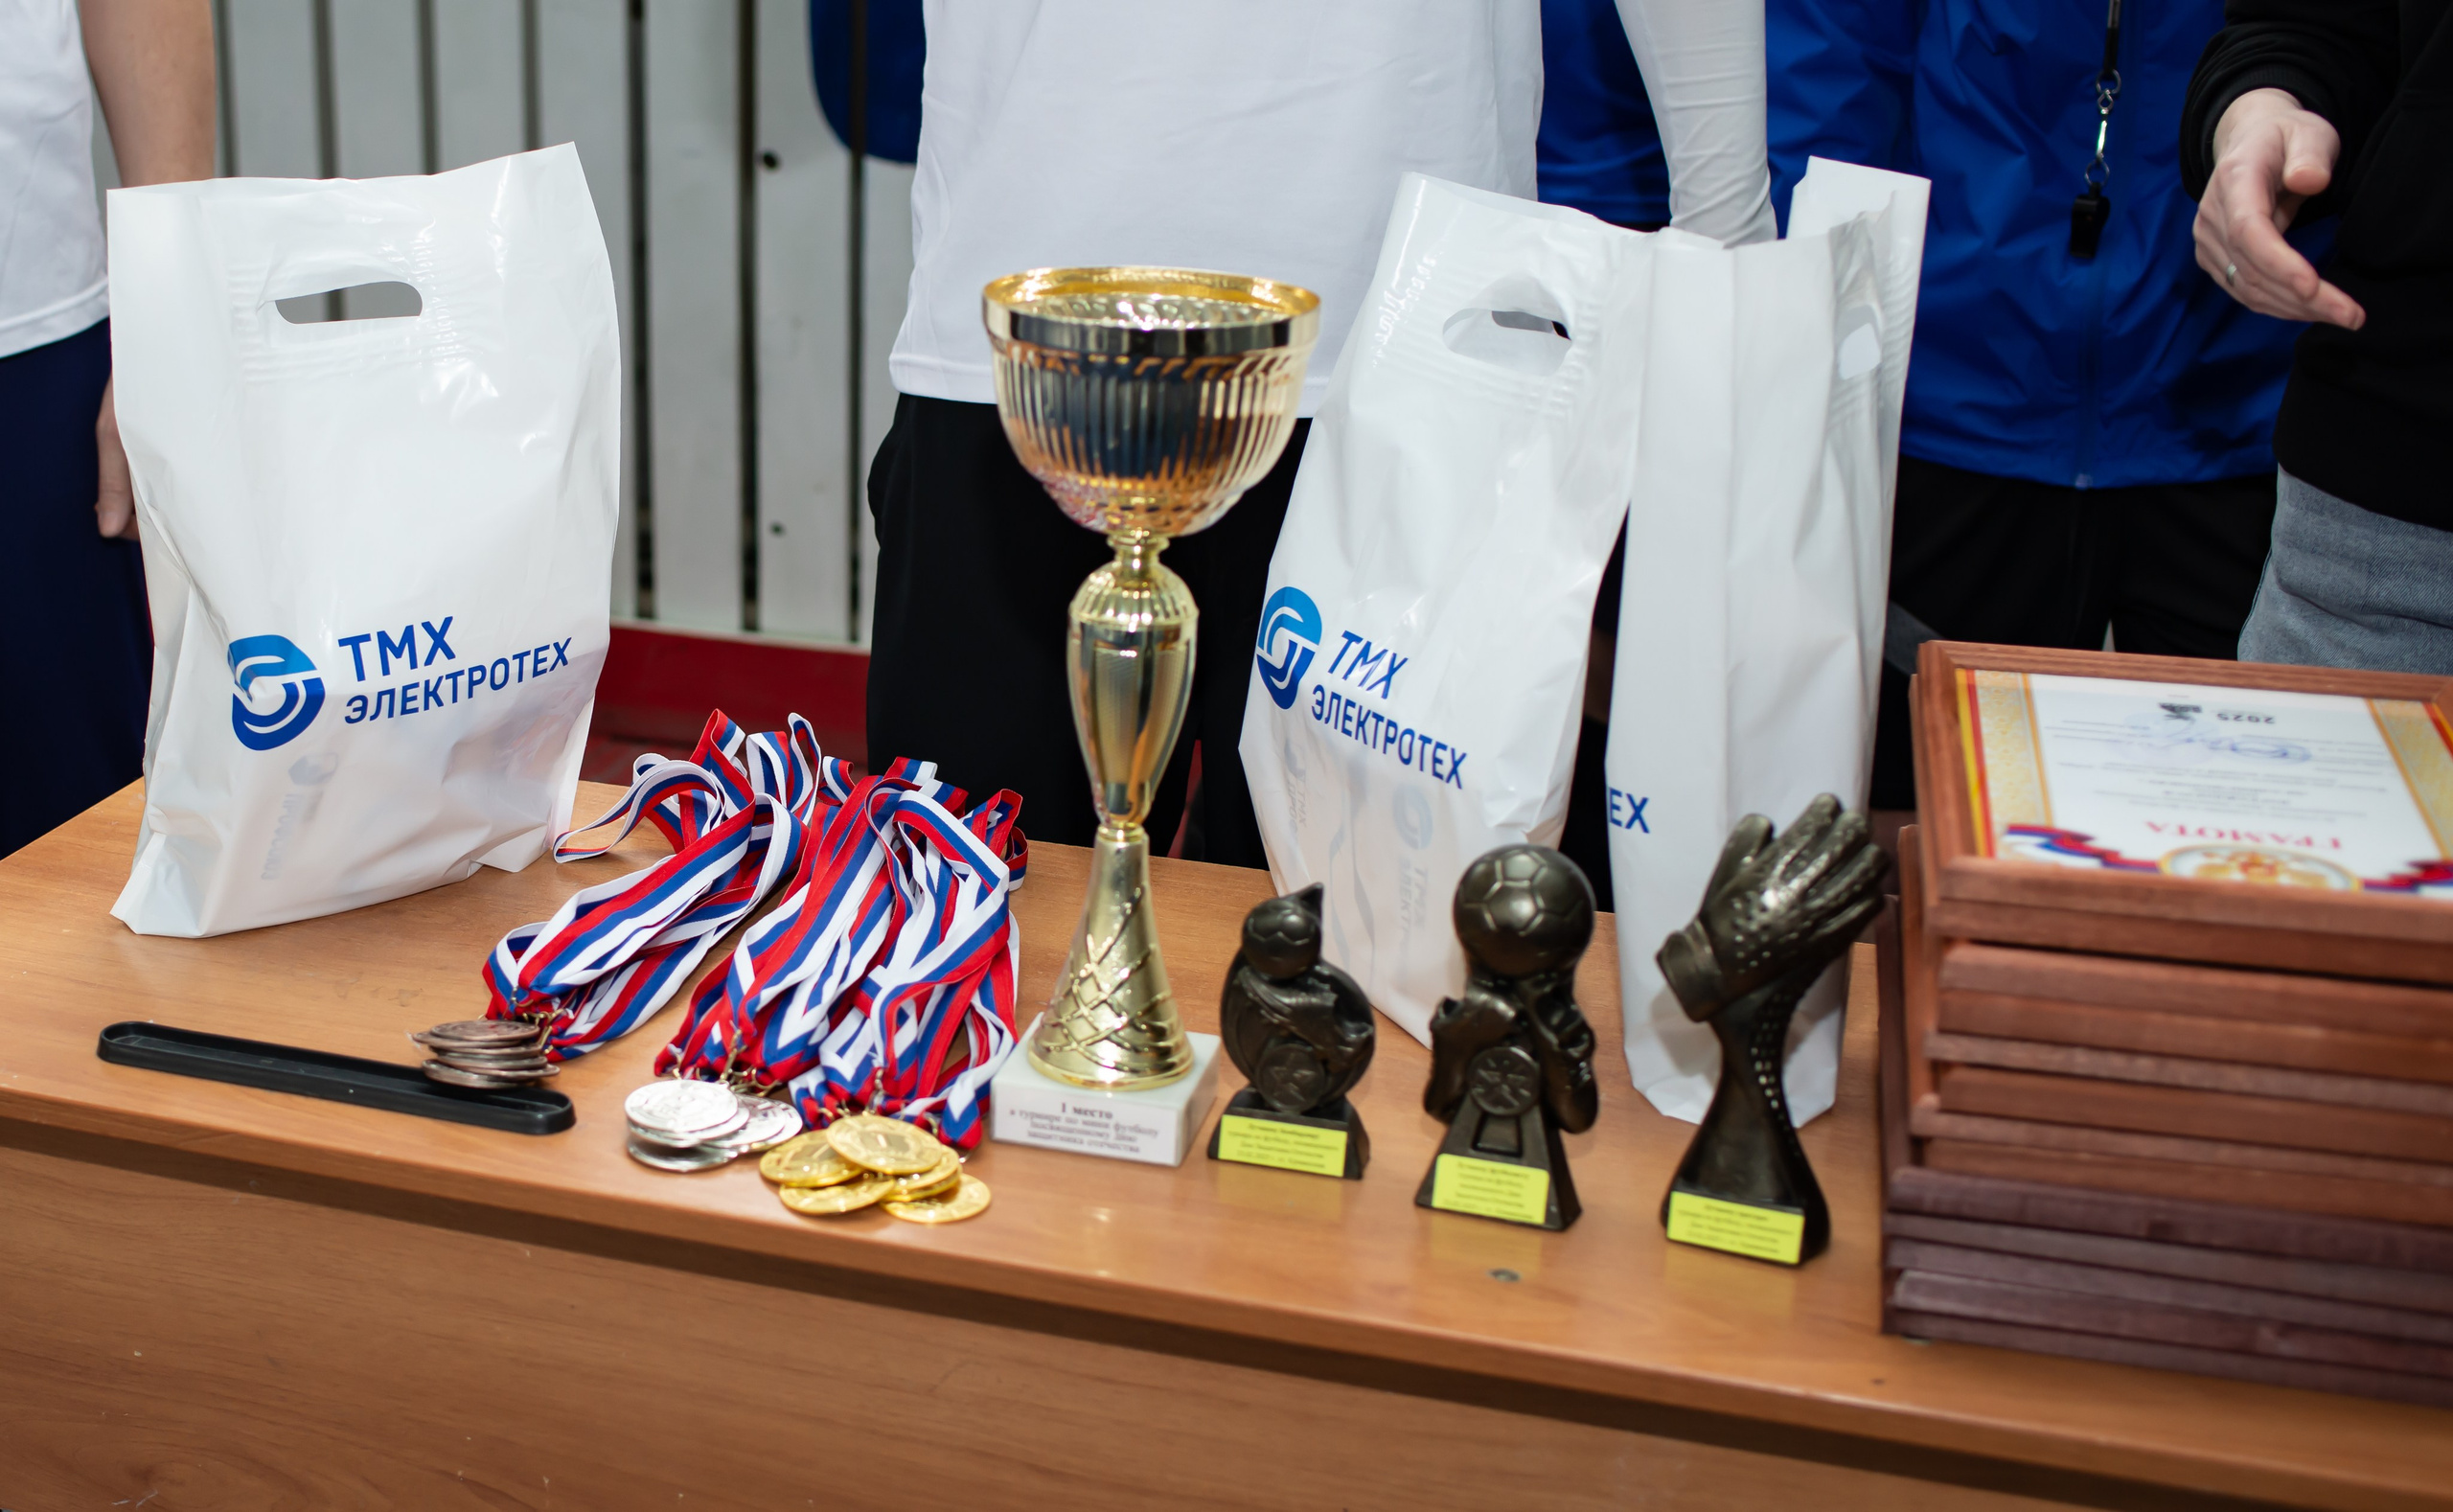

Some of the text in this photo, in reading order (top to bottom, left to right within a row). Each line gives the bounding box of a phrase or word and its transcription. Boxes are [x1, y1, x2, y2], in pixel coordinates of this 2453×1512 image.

[338, 616, 456, 681] ТМХ
[345, 637, 572, 723] ЭЛЕКТРОТЕХ
[1328, 630, 1409, 699] ТМХ
[1312, 684, 1467, 790] ЭЛЕКТРОТЕХ
[2216, 713, 2276, 724] 2025
[2145, 821, 2342, 850] ГРАМОТА
[1073, 1106, 1112, 1119] место
